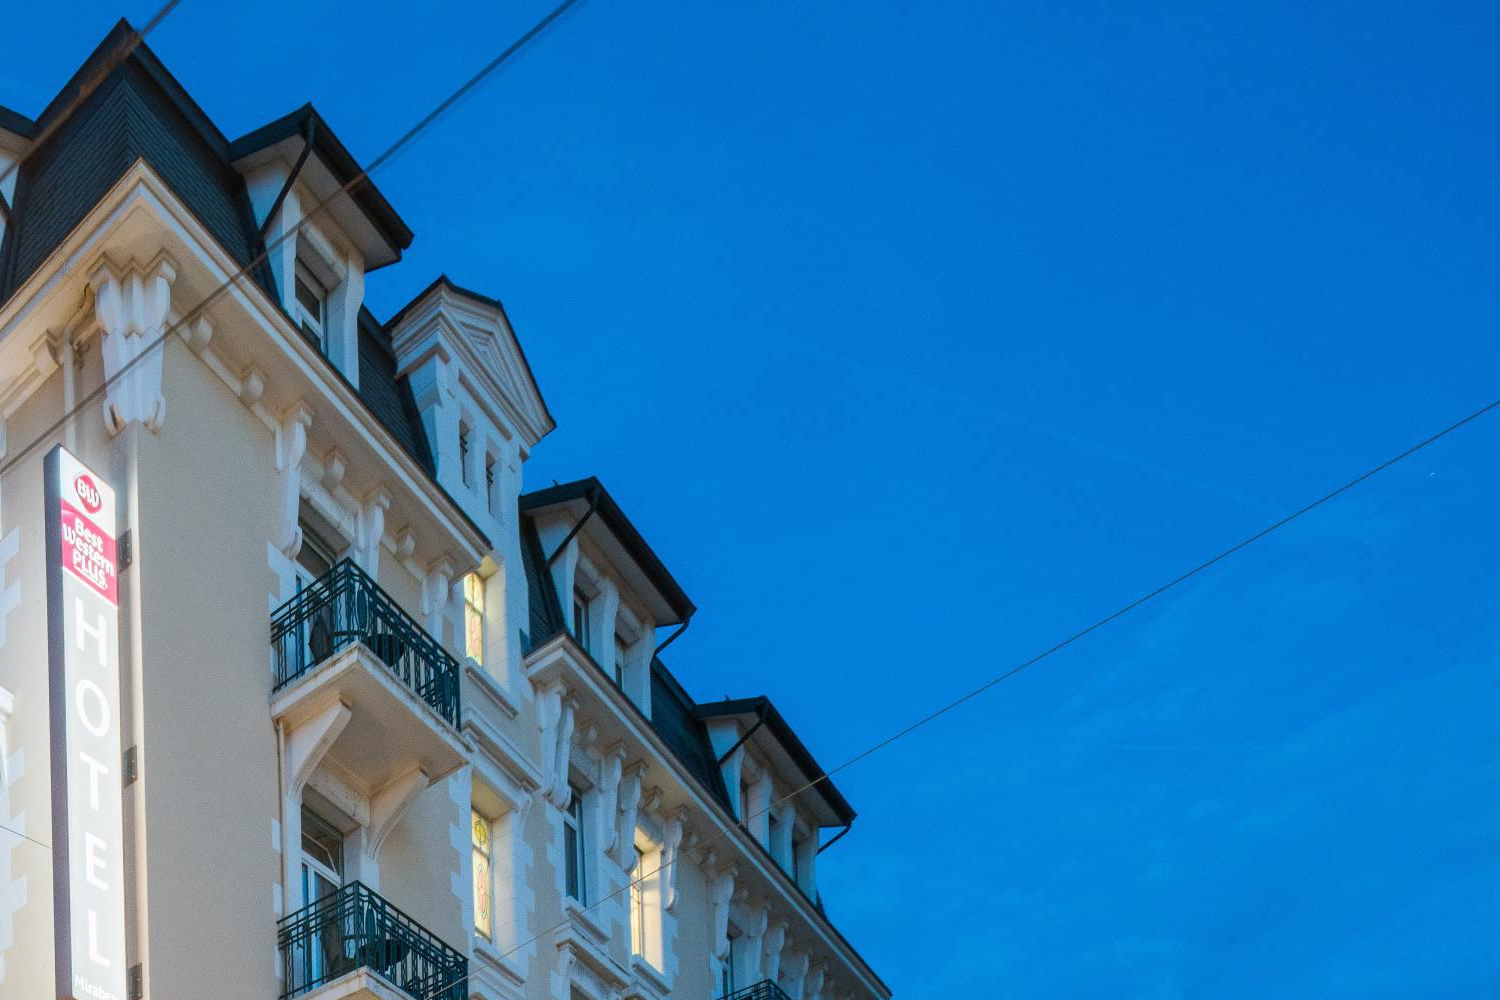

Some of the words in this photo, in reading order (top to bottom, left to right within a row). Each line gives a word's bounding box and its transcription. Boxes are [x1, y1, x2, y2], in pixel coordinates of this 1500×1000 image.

[76, 477, 100, 508] BW
[62, 522, 114, 577] Western
[75, 517, 103, 552] Best
[73, 548, 106, 587] PLUS
[75, 597, 111, 968] HOTEL
